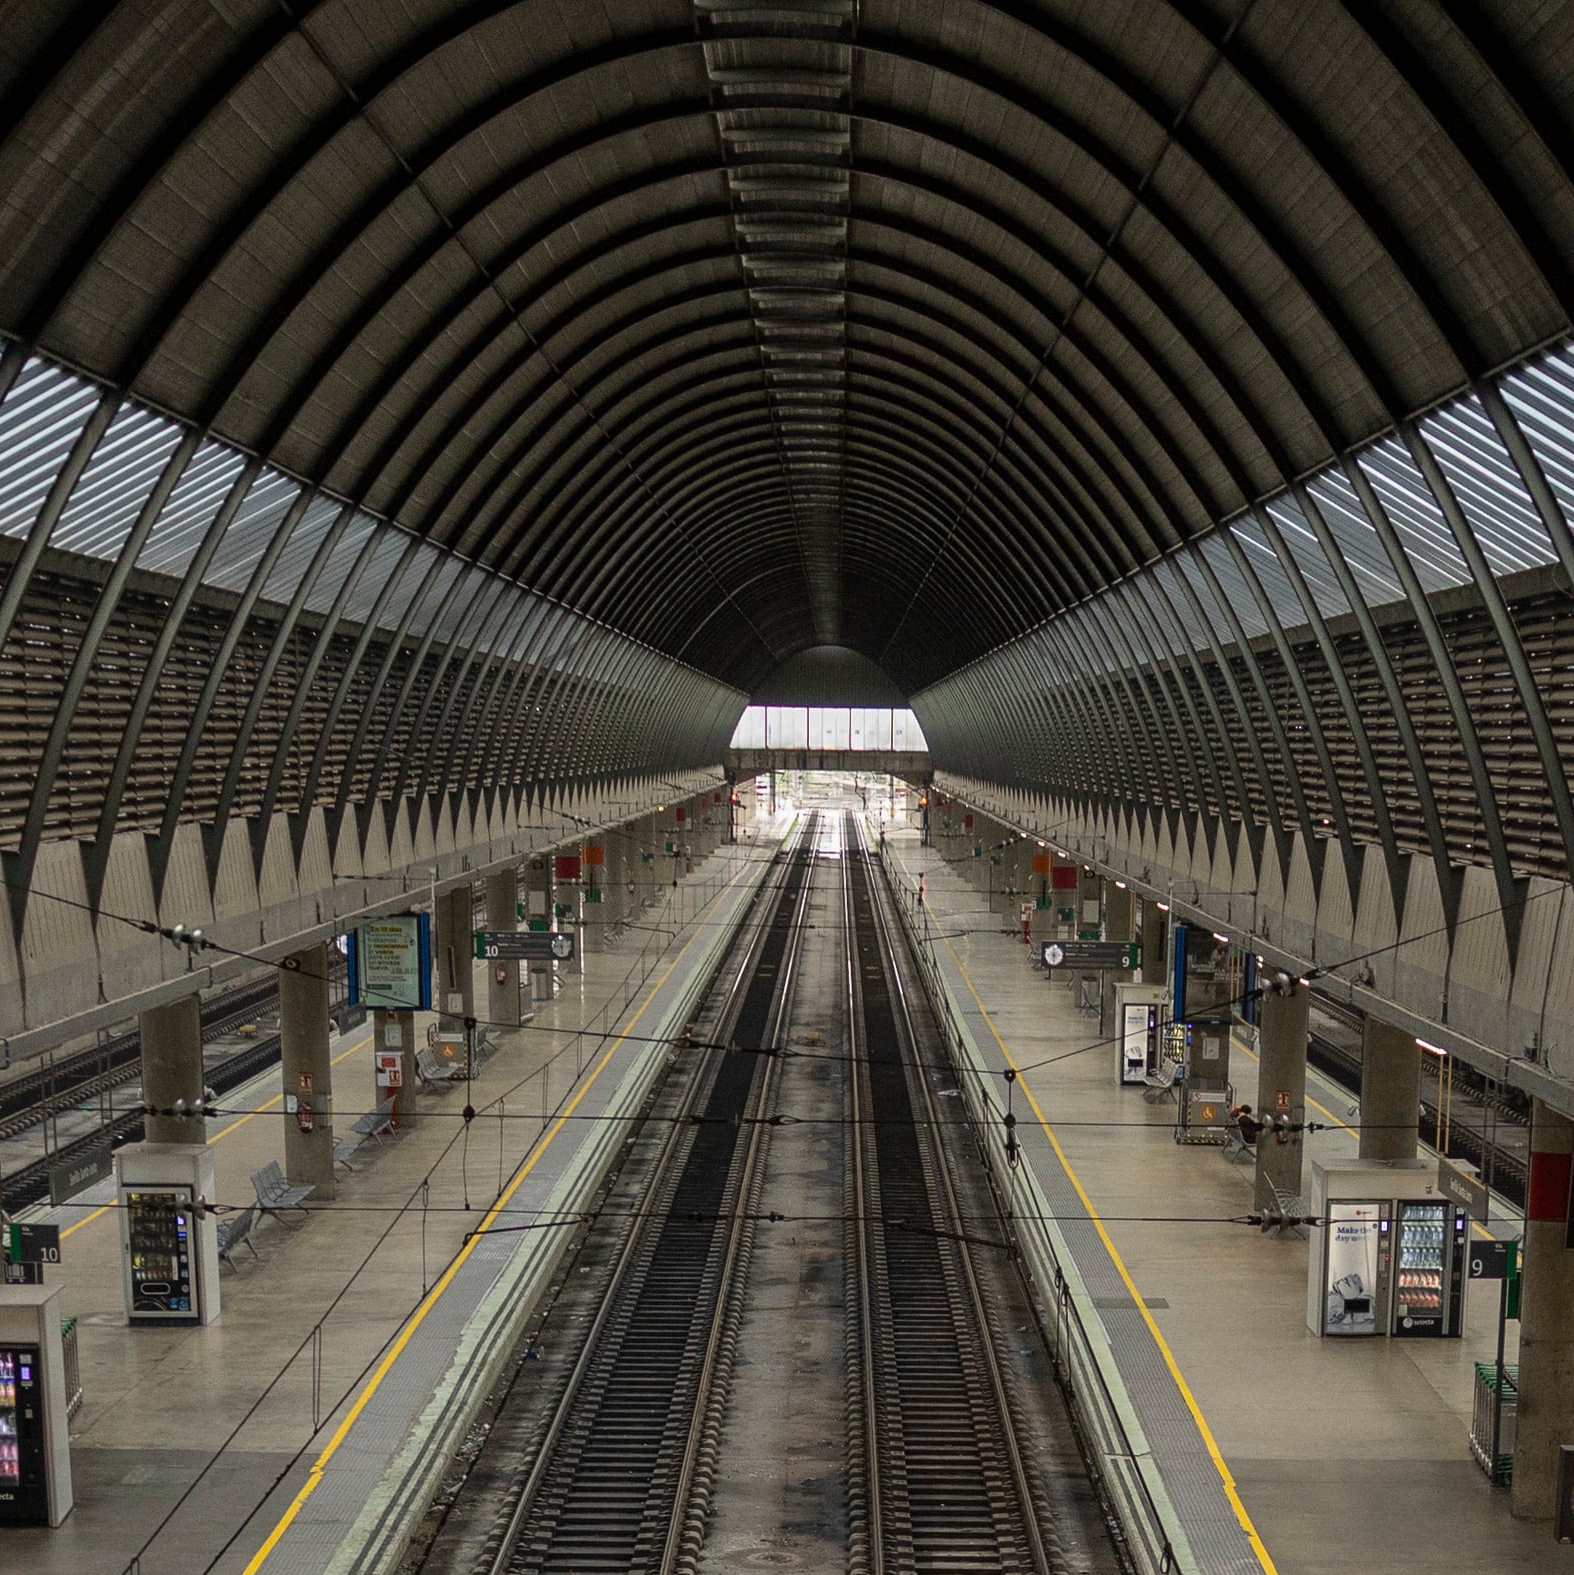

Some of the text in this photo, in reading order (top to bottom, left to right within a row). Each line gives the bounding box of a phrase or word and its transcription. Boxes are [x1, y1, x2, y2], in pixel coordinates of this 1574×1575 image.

[484, 945, 498, 957] 10
[1122, 956, 1130, 967] 9
[40, 1247, 58, 1262] 10
[1472, 1259, 1483, 1277] 9
